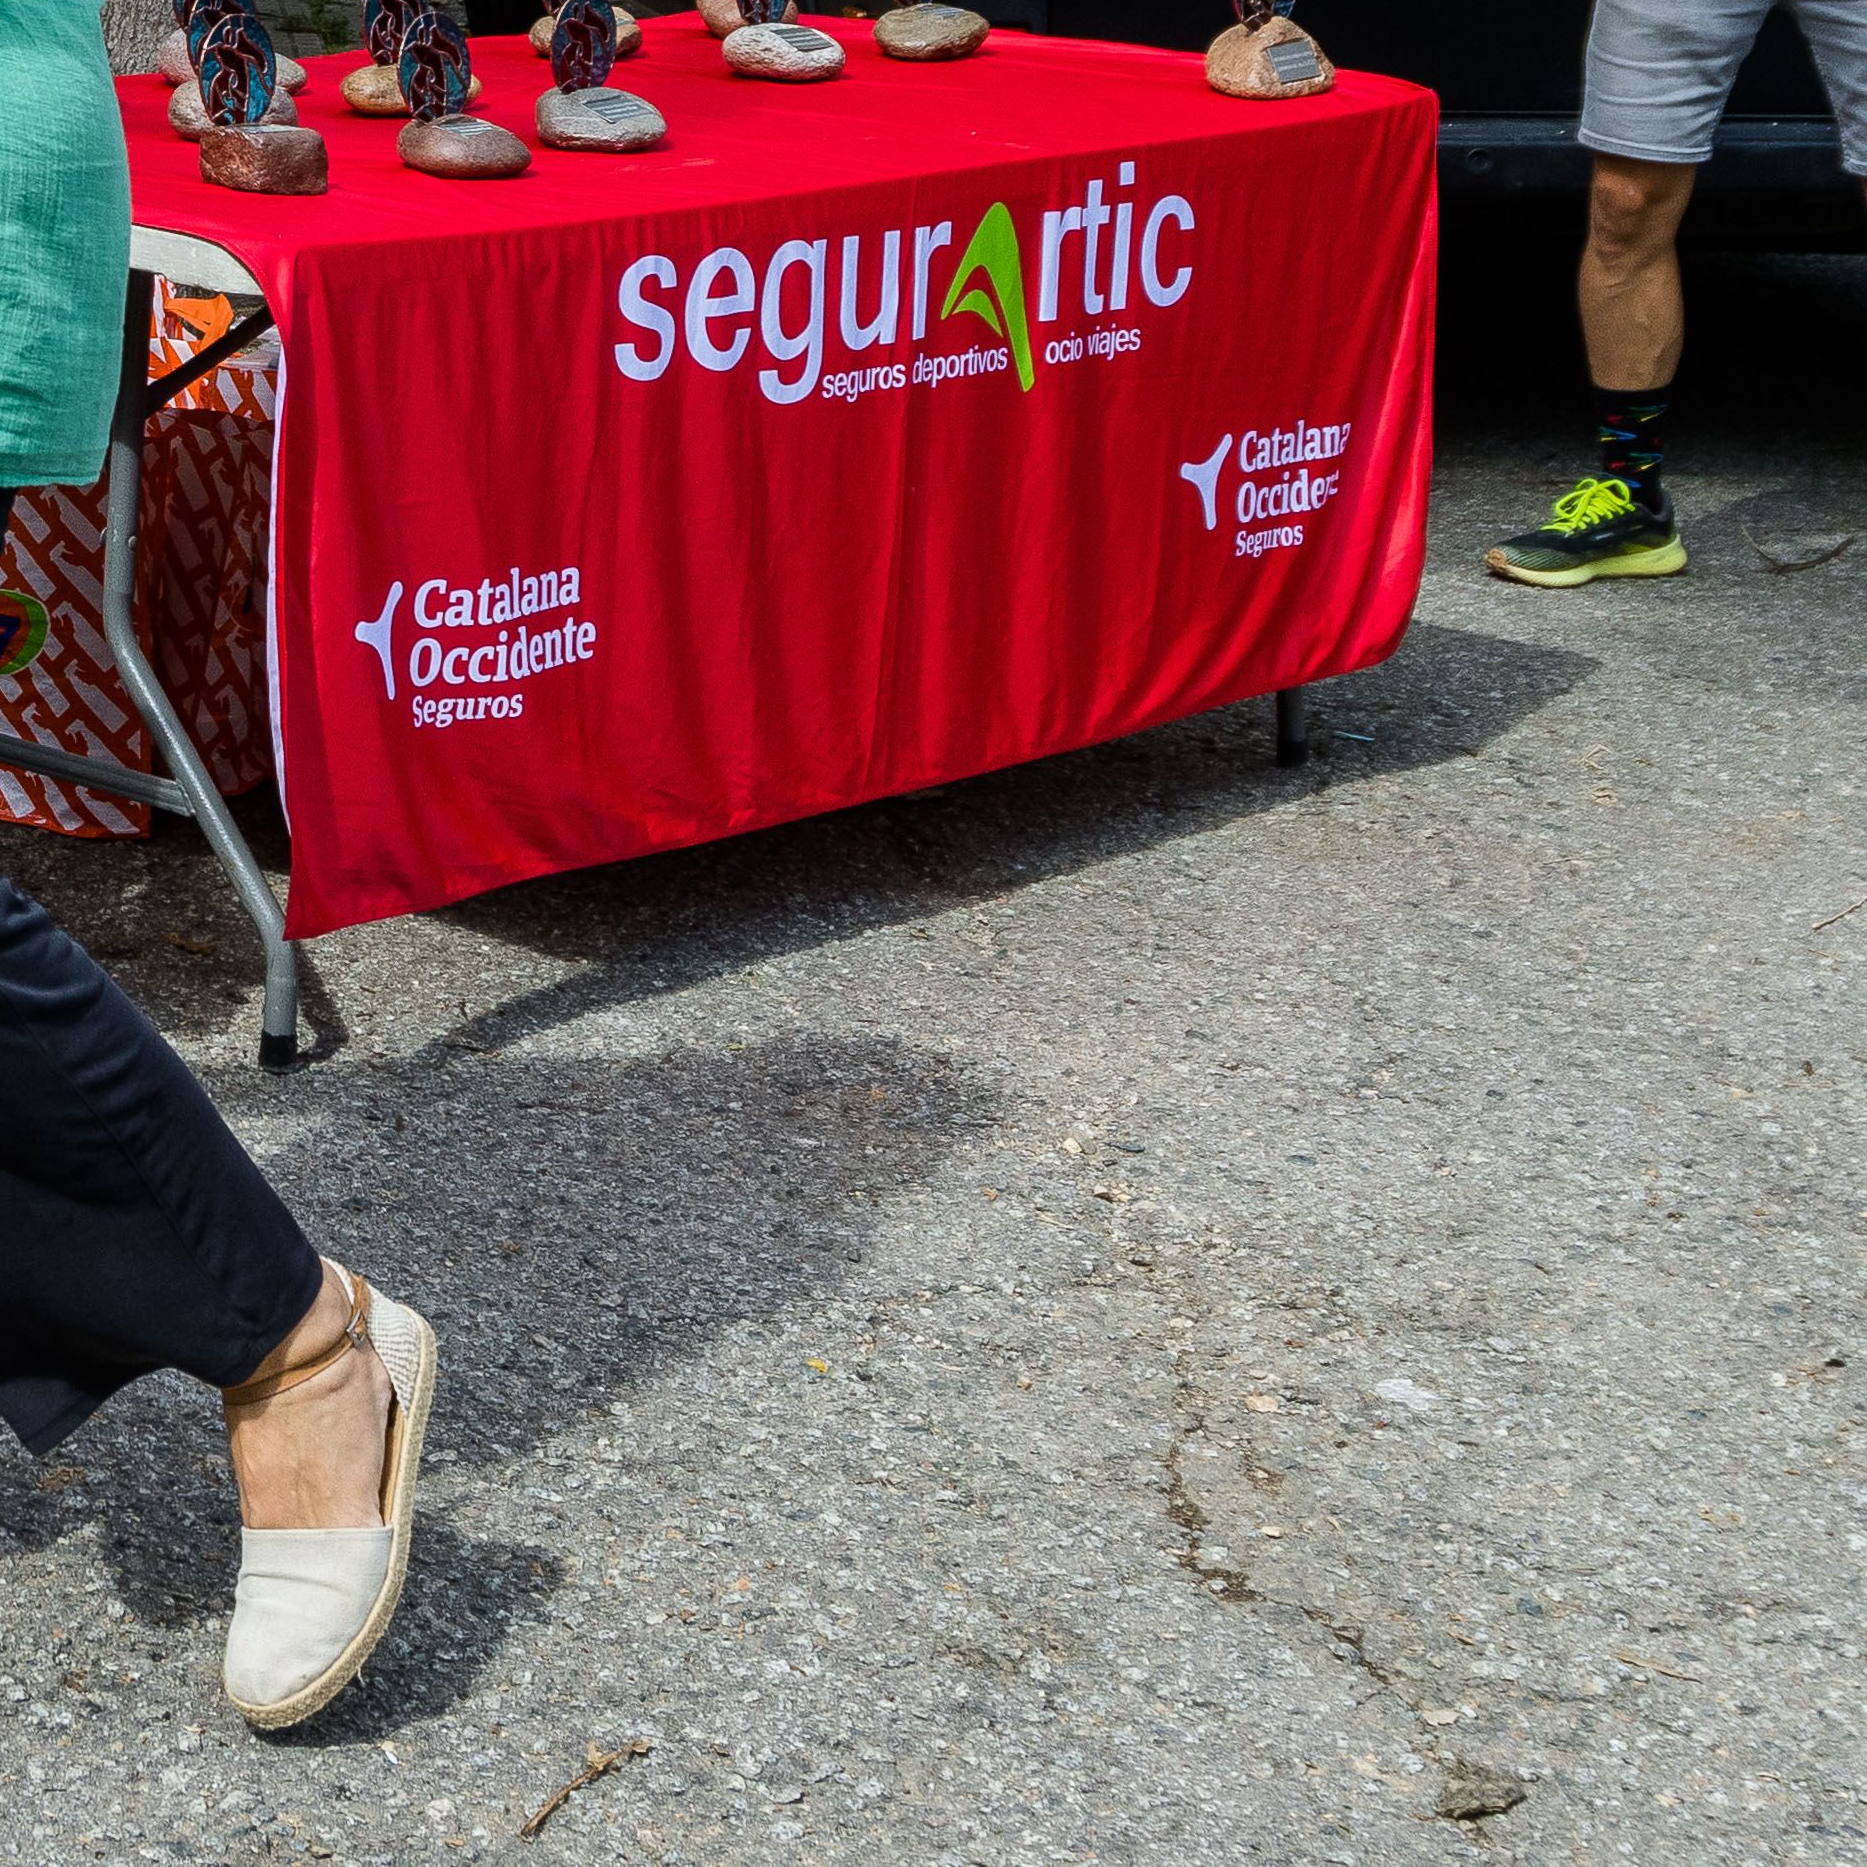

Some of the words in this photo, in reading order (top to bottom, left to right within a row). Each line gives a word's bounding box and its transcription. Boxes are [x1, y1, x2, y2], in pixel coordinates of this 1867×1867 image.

[822, 360, 906, 401] seguros
[912, 344, 1009, 388] deportivos
[1044, 334, 1084, 365] ocio
[1086, 327, 1142, 361] viajes
[1235, 523, 1304, 558] Seguros
[414, 565, 580, 628] Catalana
[409, 615, 597, 689] Occidente
[412, 691, 524, 728] Seguros
